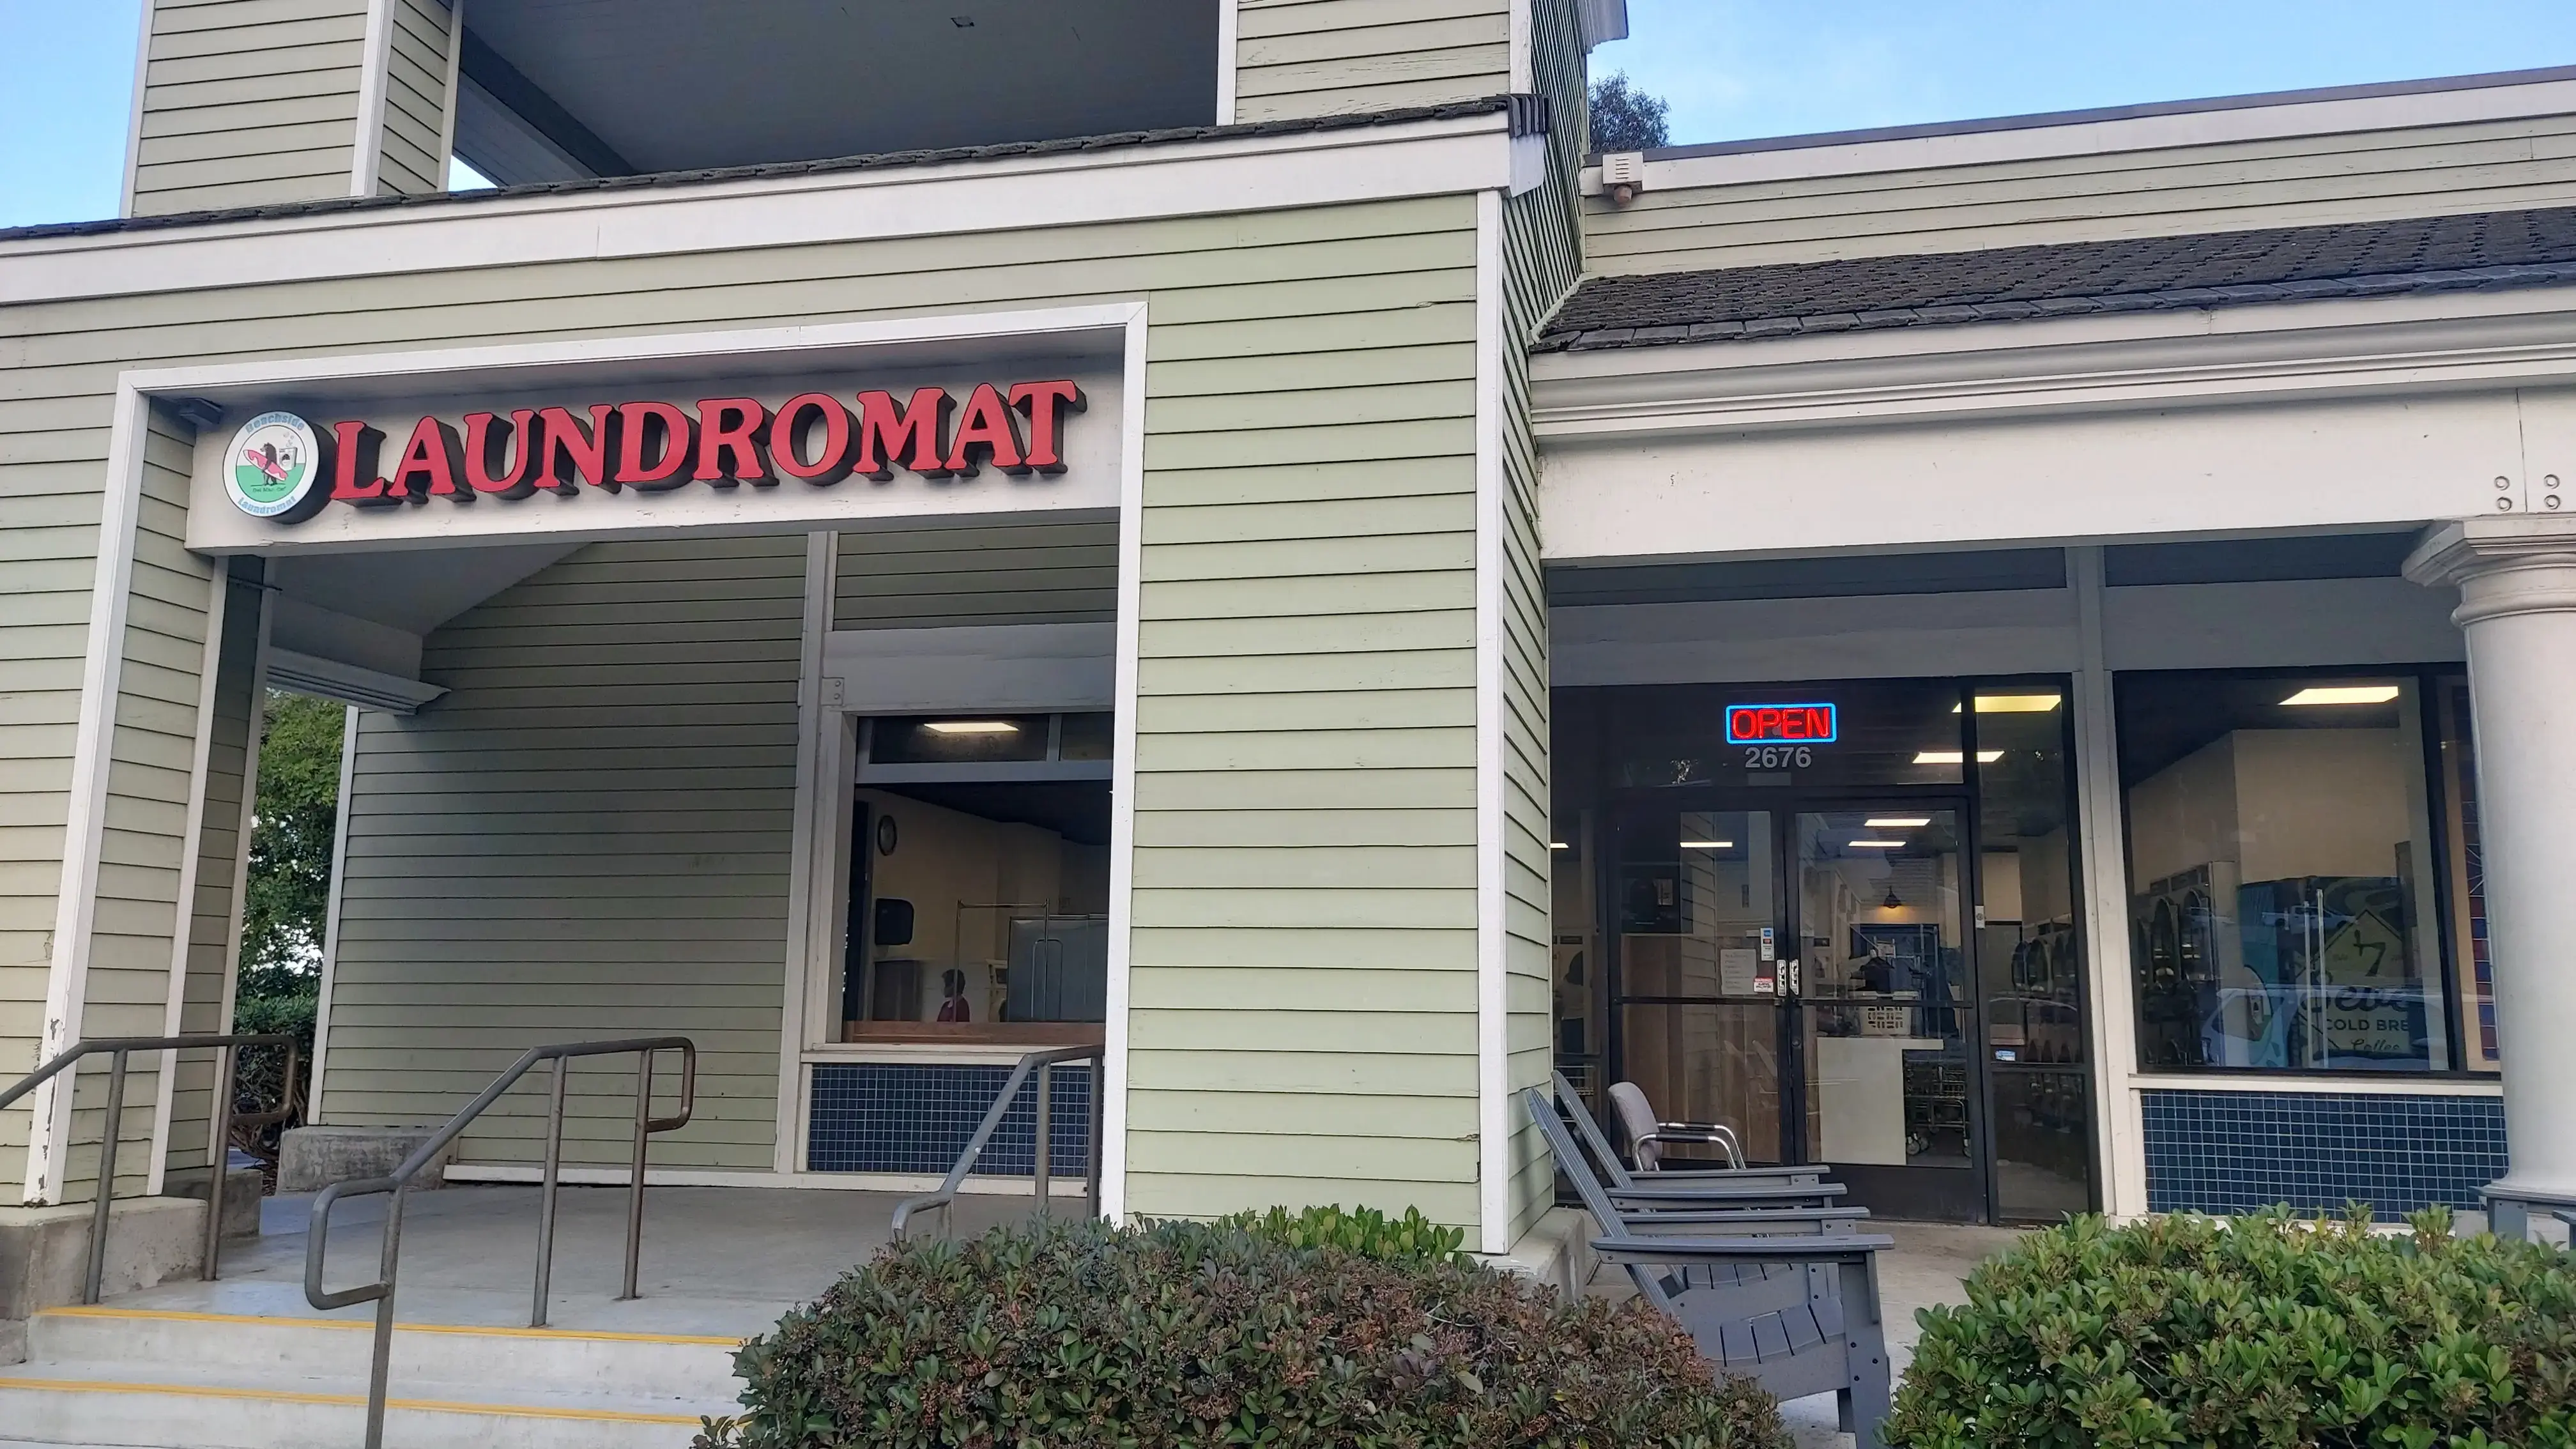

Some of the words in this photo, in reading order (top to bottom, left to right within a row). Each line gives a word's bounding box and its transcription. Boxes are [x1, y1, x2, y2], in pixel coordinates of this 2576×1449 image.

[245, 413, 305, 434] Beachside
[331, 379, 1077, 499] LAUNDROMAT
[238, 496, 296, 514] Laundromat
[1732, 708, 1830, 739] OPEN
[1745, 746, 1812, 768] 2676
